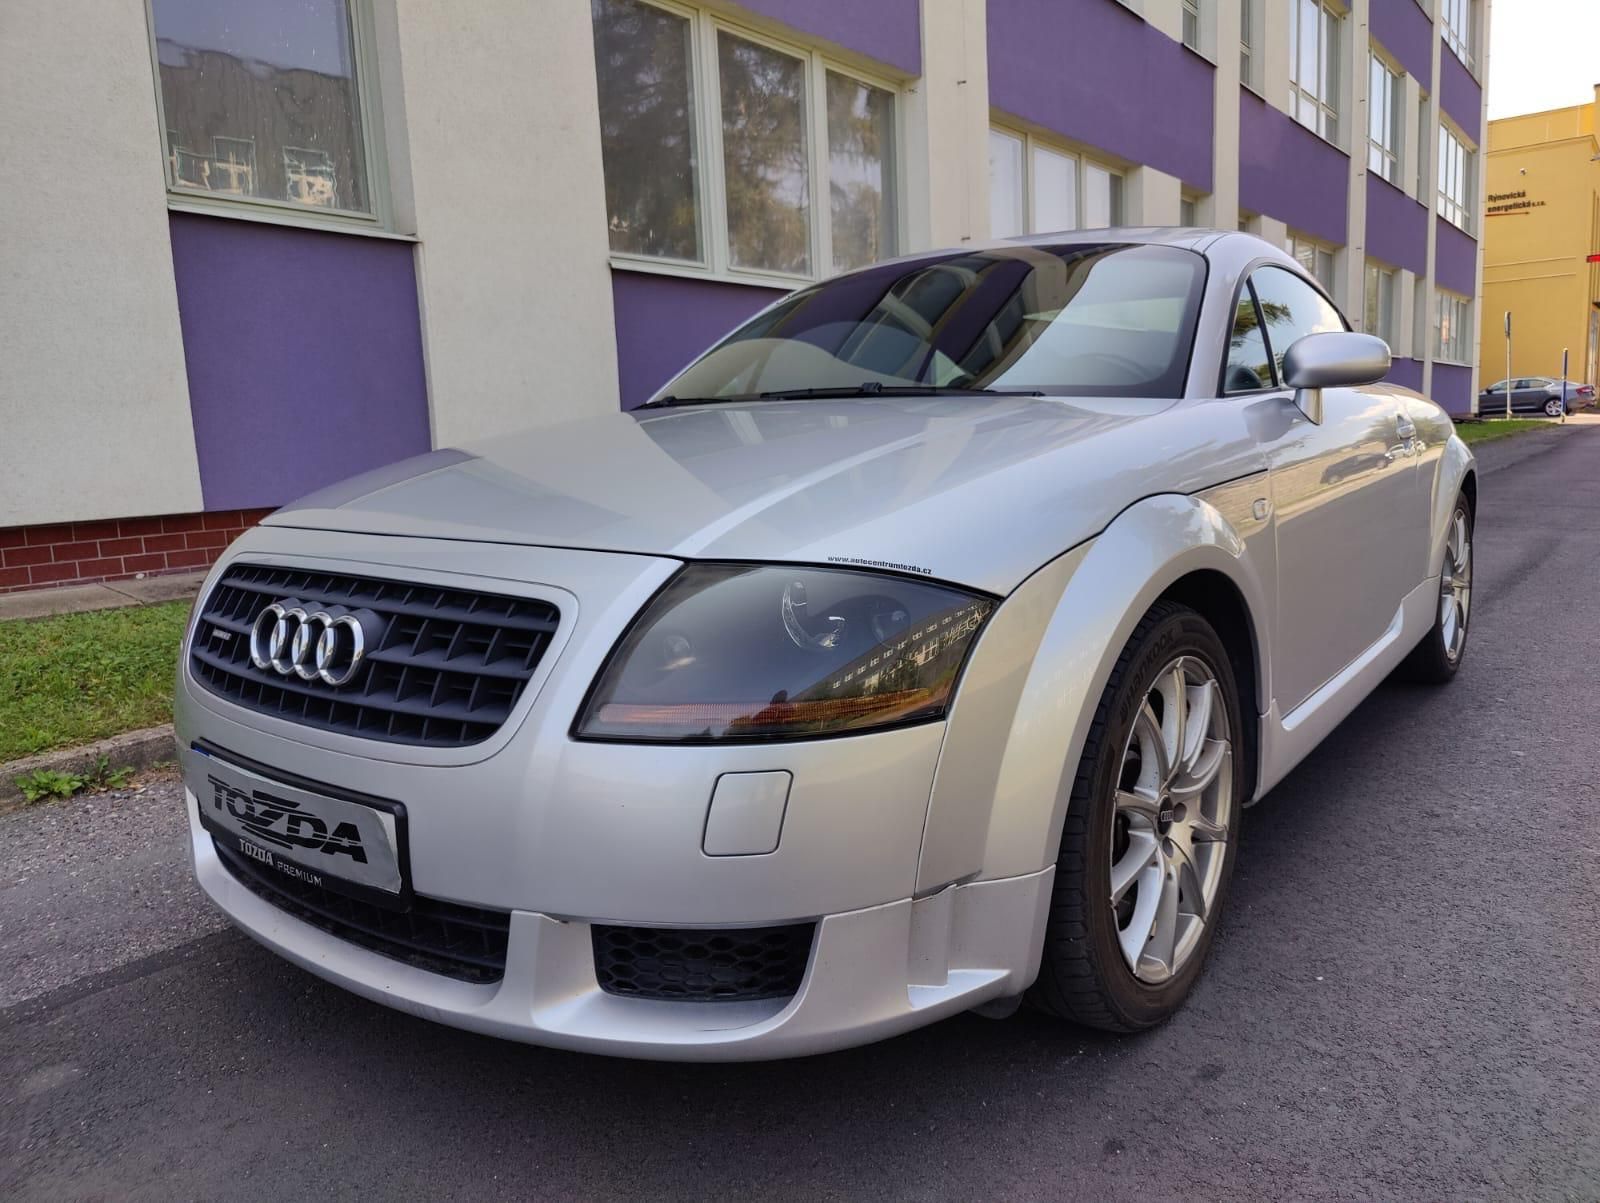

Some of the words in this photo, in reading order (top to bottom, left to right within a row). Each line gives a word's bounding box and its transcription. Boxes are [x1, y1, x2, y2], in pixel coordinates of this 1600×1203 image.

[827, 556, 932, 575] www.autocentrumtozda.cz
[207, 773, 368, 865] TOZDA
[239, 838, 274, 866] TOZDA
[276, 860, 323, 887] PREMIUM
